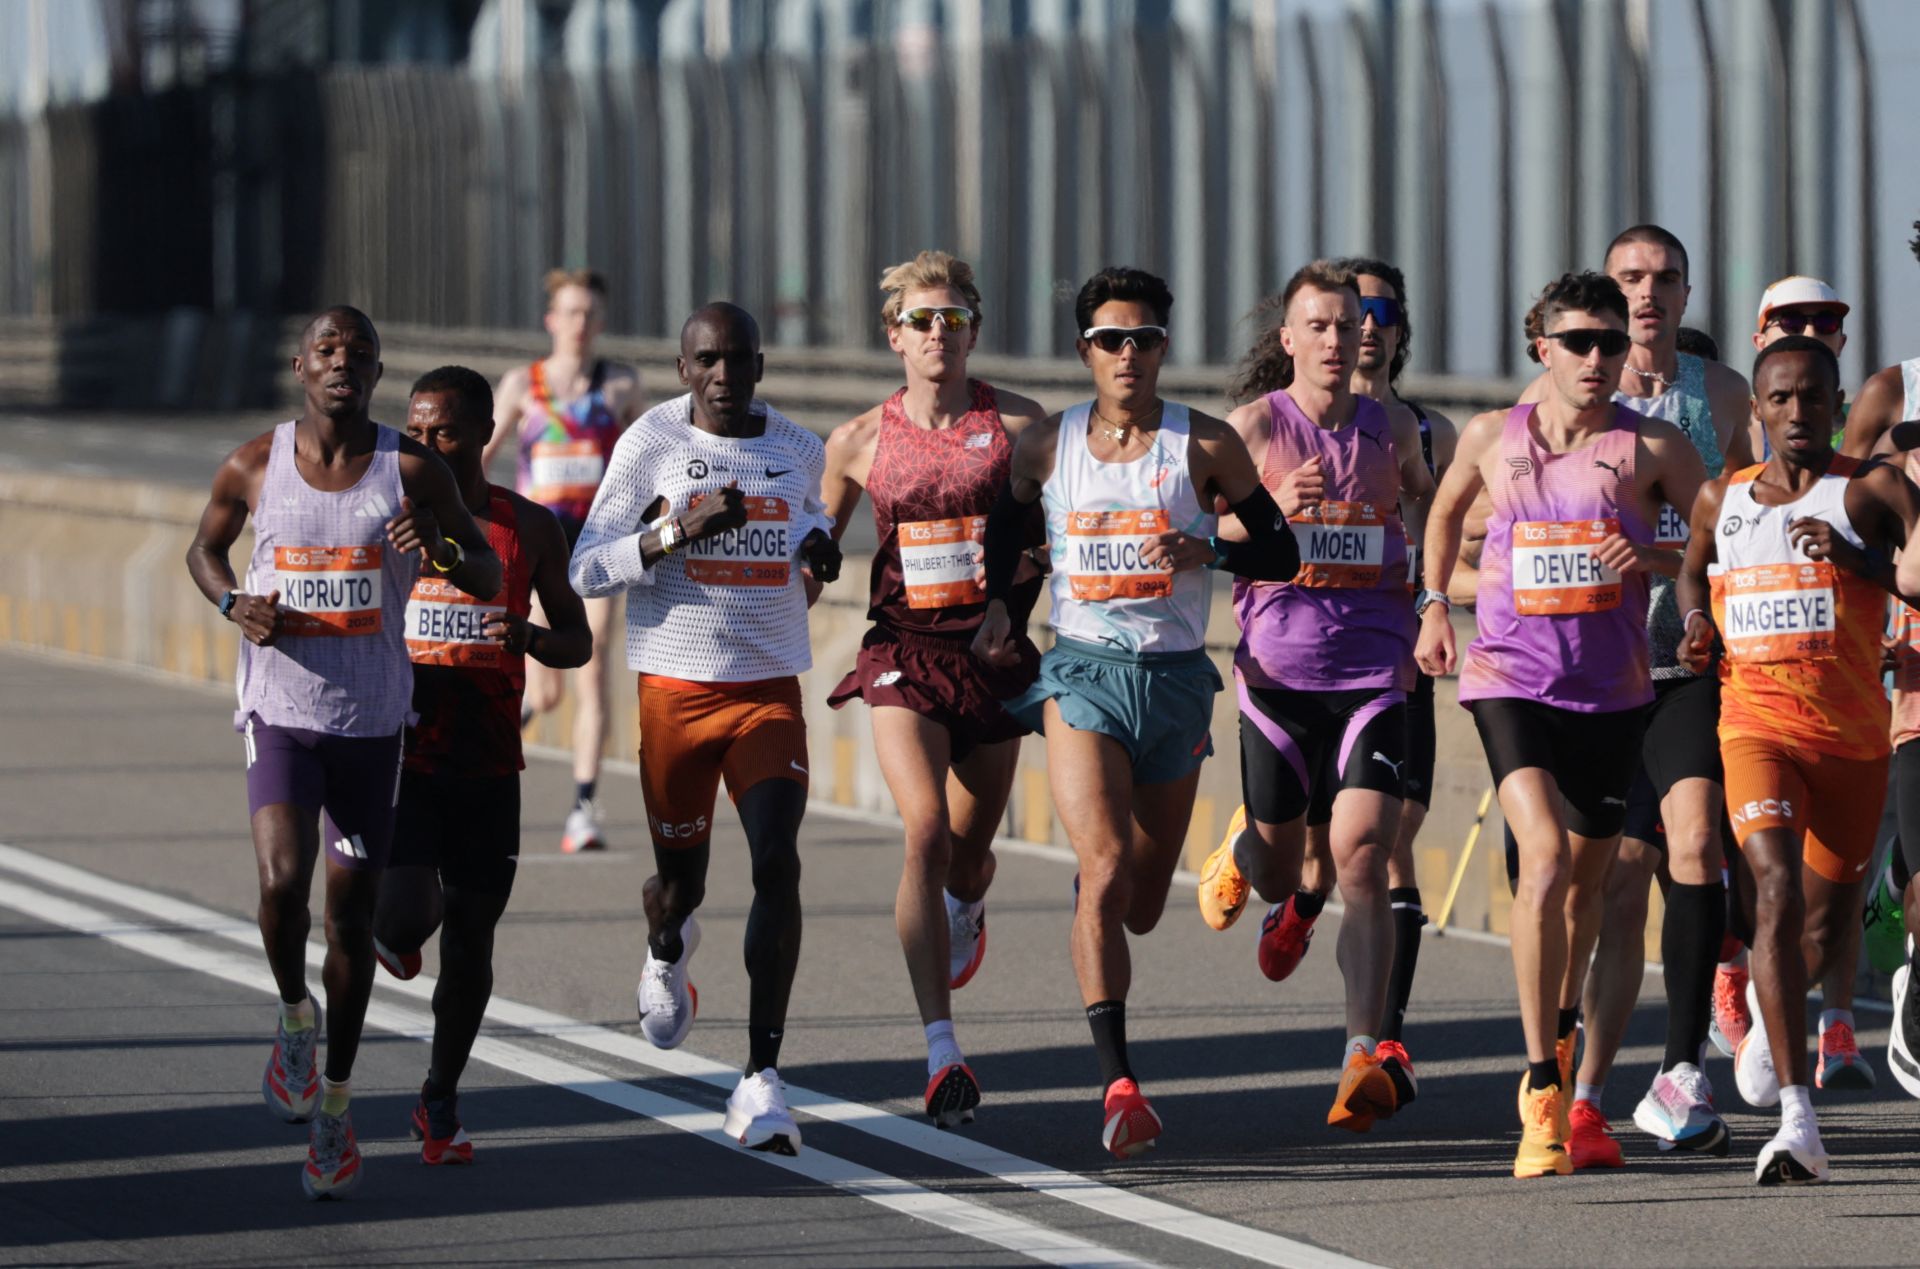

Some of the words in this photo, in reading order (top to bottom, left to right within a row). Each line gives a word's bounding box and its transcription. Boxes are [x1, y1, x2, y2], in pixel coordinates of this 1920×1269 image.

[1077, 514, 1098, 529] tcs
[911, 525, 931, 540] tcs
[1525, 526, 1546, 540] tcs
[690, 528, 787, 556] KIPCHOGE
[1310, 531, 1366, 560] MOEN
[286, 549, 308, 565] tcs
[1079, 542, 1158, 571] MEUCC
[756, 568, 785, 579] 2025
[1534, 553, 1603, 584] DEVER
[1735, 573, 1757, 588] tcs
[285, 577, 372, 607] KIPRUTO
[416, 581, 439, 596] tcs
[1586, 592, 1617, 604] 2025
[347, 616, 375, 628] 2025
[1732, 597, 1826, 633] NAGEEYE
[418, 608, 489, 641] BEKELE
[1797, 640, 1829, 651] 2025
